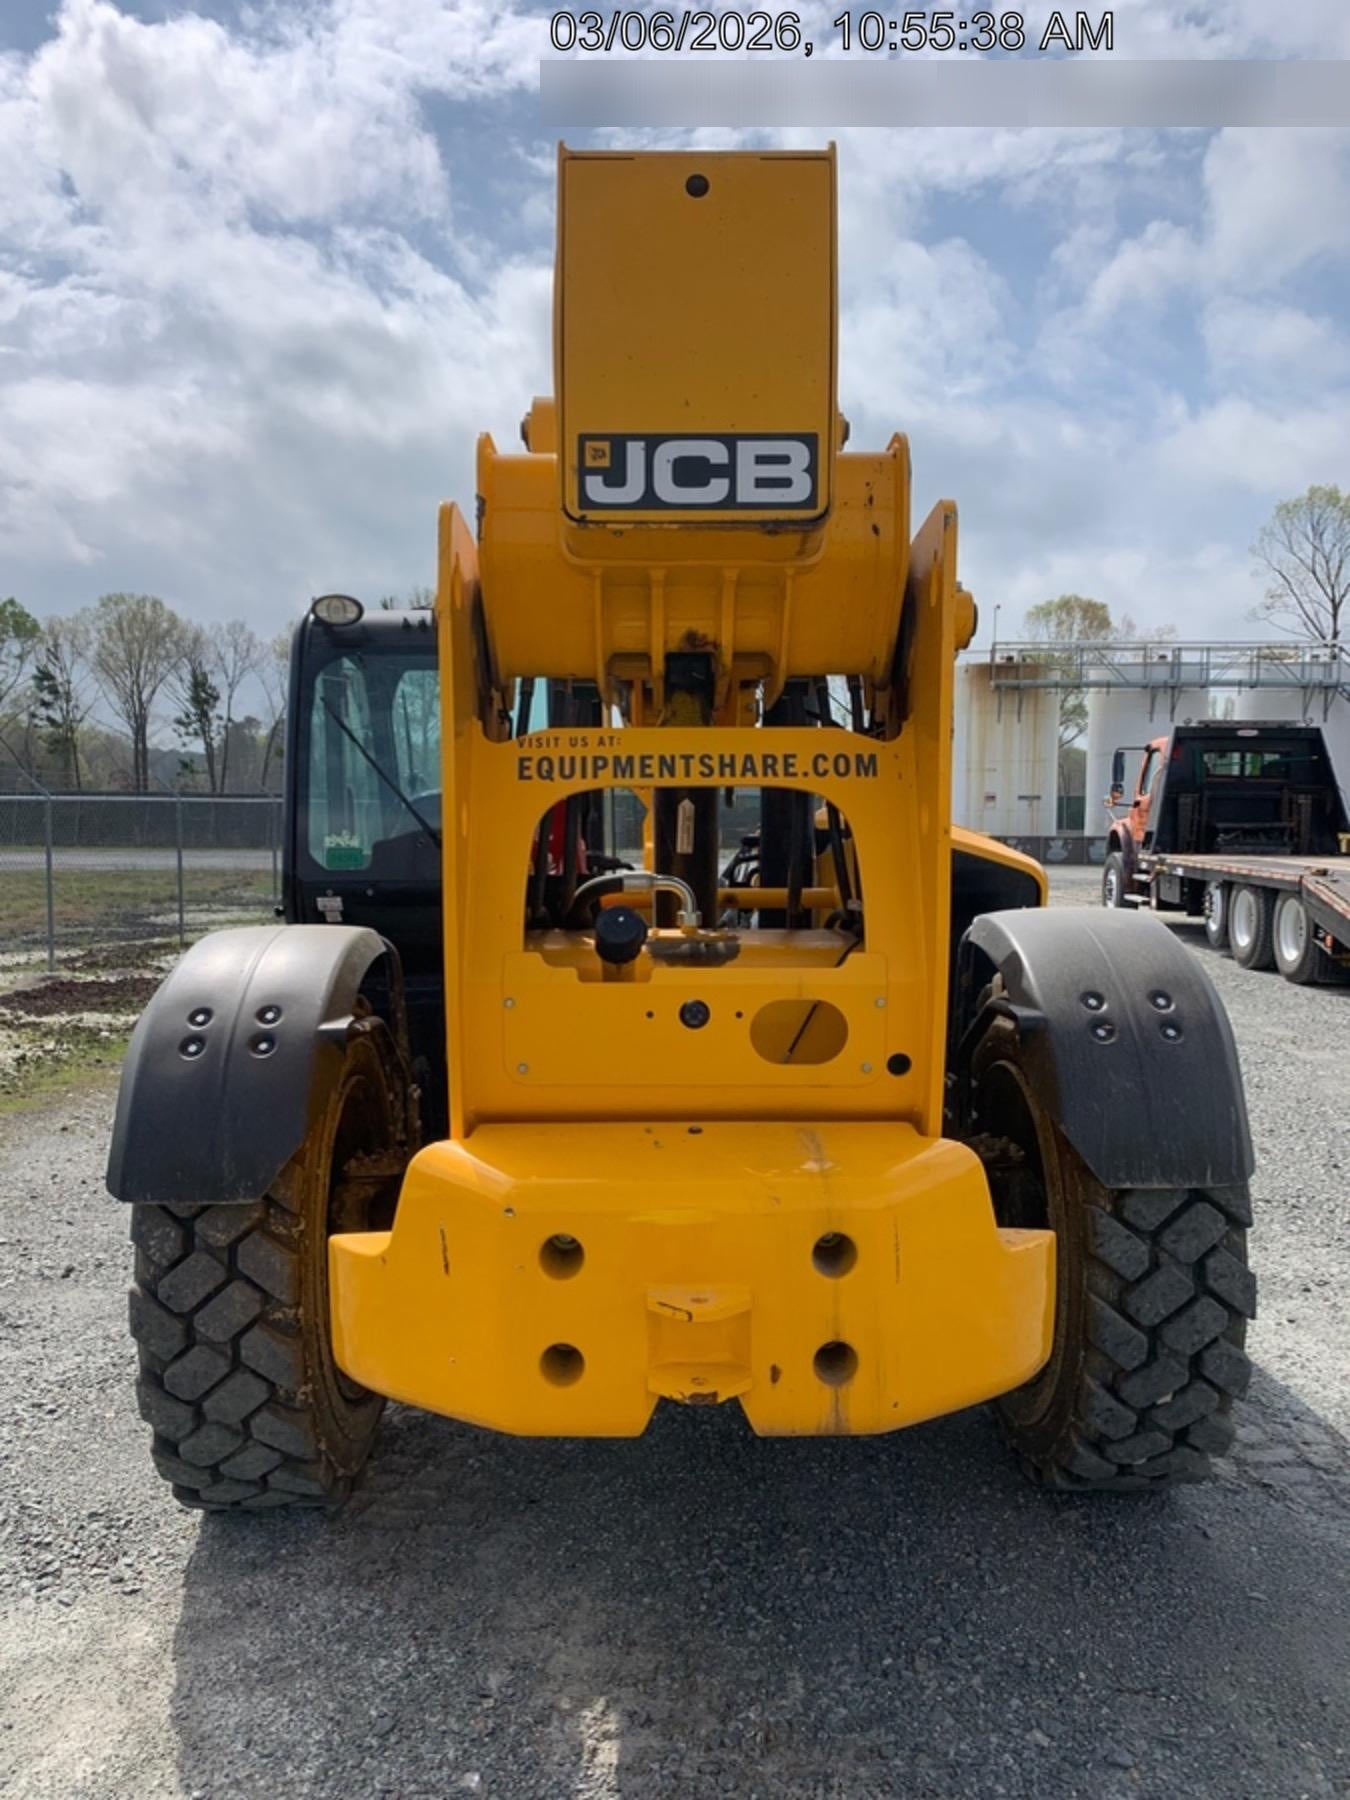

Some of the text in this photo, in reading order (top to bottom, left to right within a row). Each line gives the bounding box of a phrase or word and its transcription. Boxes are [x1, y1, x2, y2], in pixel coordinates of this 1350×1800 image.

[585, 440, 812, 504] JCB
[517, 736, 621, 748] VISIT US AT:
[517, 753, 878, 781] EQUIPMENTSHARE.COM
